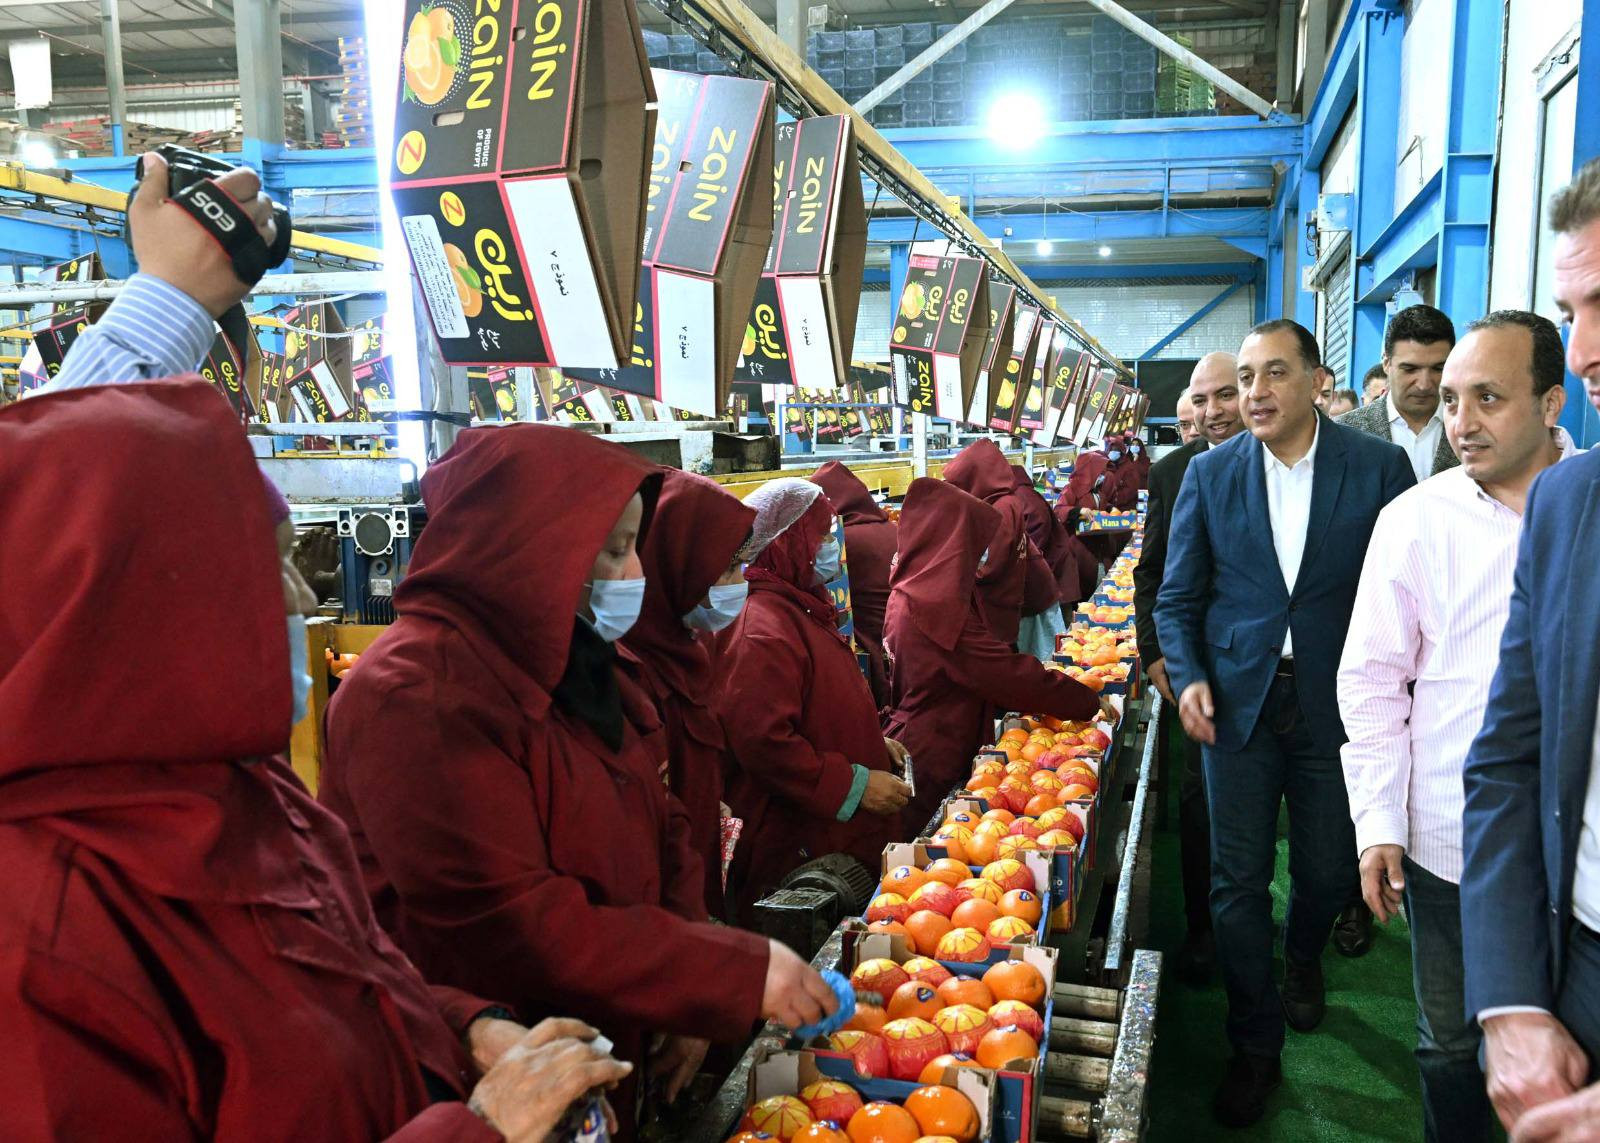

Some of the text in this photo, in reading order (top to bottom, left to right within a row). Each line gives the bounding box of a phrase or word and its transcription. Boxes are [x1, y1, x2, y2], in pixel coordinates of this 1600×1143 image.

[527, 0, 566, 101] aiN
[473, 129, 484, 168] OF EGYPT
[481, 128, 492, 168] PRODUCE
[190, 191, 236, 232] EOS
[474, 228, 534, 321] زين
[550, 262, 568, 297] نموذج
[949, 288, 969, 324] زين
[678, 334, 689, 359] نموذج
[755, 303, 788, 361] زين
[1101, 518, 1120, 527] Hana
